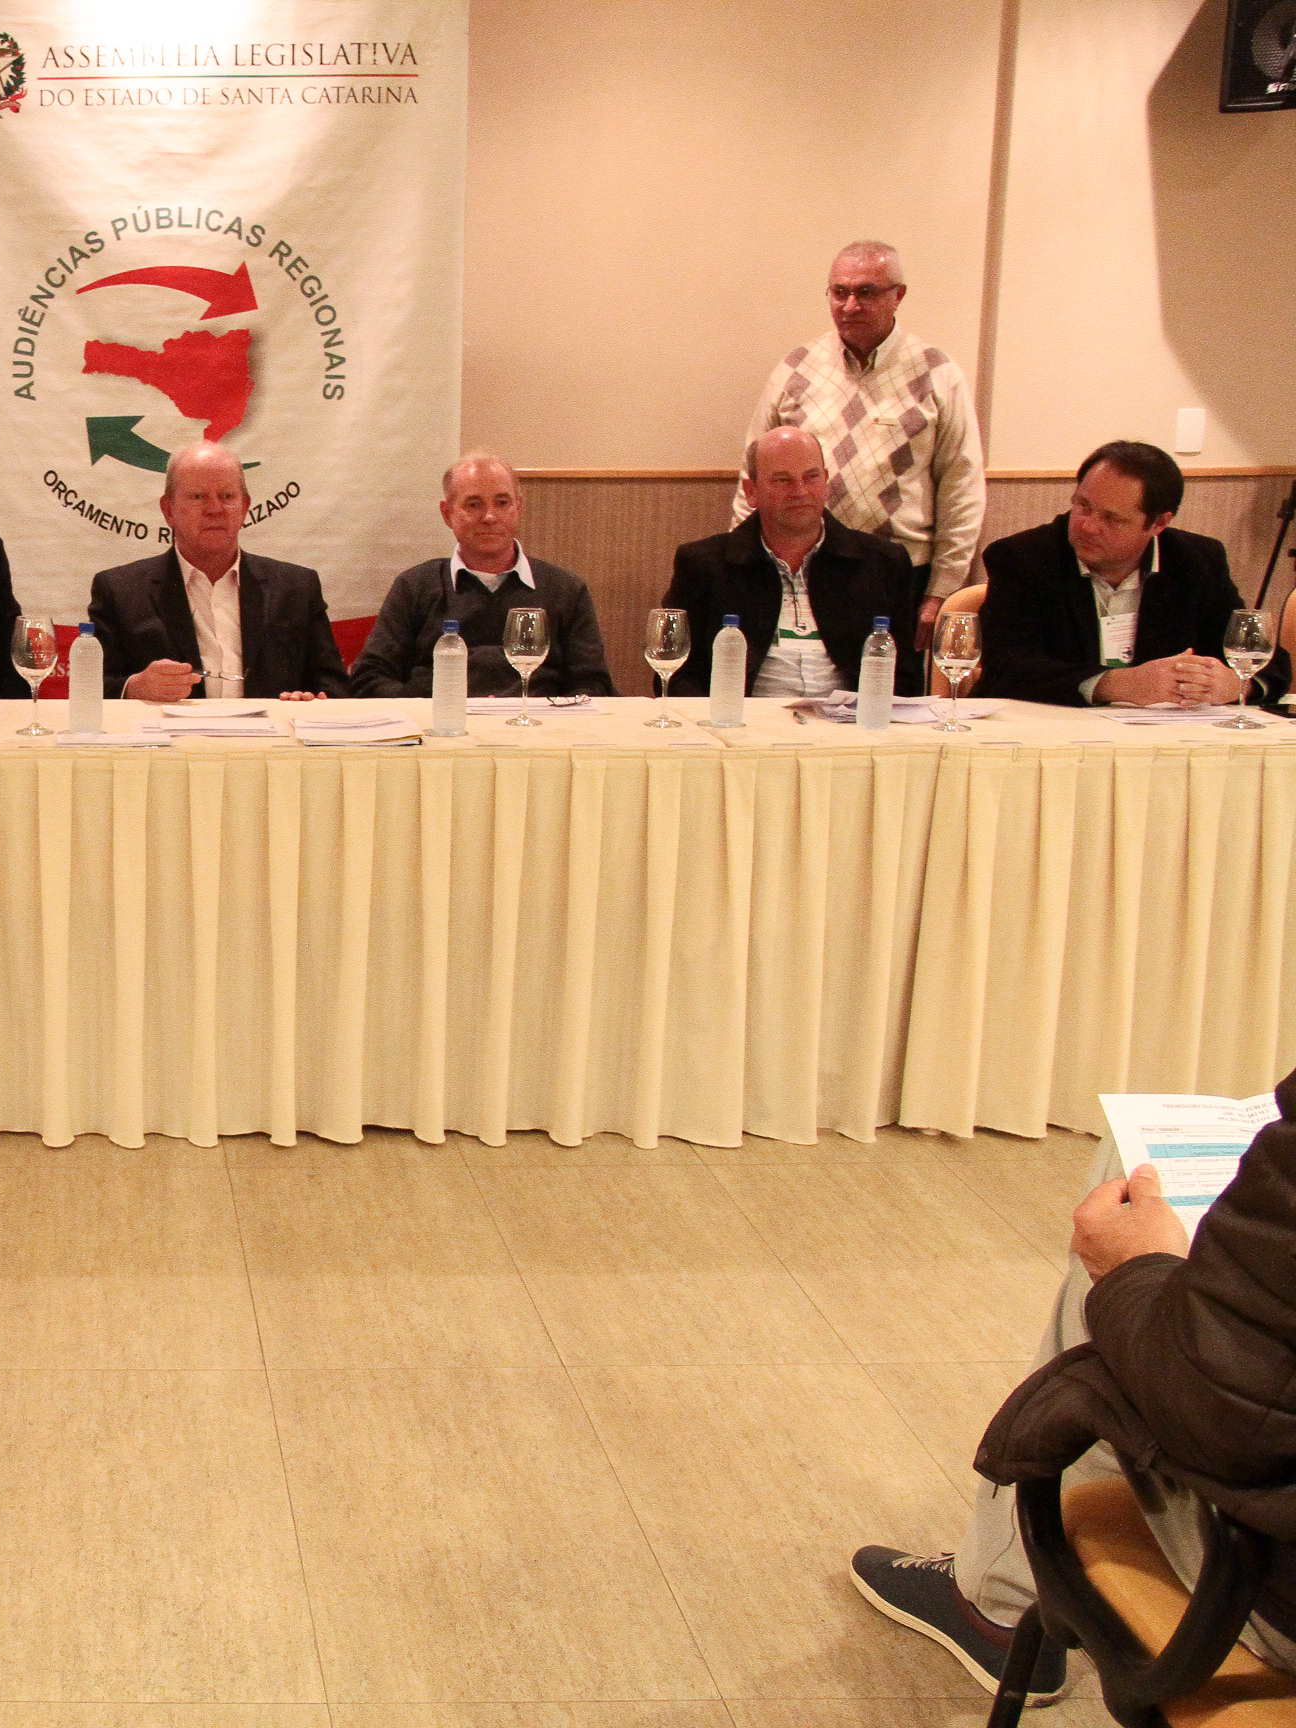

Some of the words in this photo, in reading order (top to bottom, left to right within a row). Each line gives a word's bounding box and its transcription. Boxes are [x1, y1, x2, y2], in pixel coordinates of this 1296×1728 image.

[42, 44, 220, 69] ASSEMBLEIA
[234, 42, 419, 67] LEGISLATIVA
[39, 88, 75, 107] DO
[84, 88, 173, 106] ESTADO
[183, 87, 212, 105] DE
[220, 87, 294, 105] SANTA
[301, 86, 419, 105] CATARINA
[13, 231, 105, 402] AUDIÊNCIAS
[111, 205, 267, 248] PÚBLICAS
[269, 239, 347, 402] REGIONAIS
[43, 469, 149, 540] ORÇAMENTO
